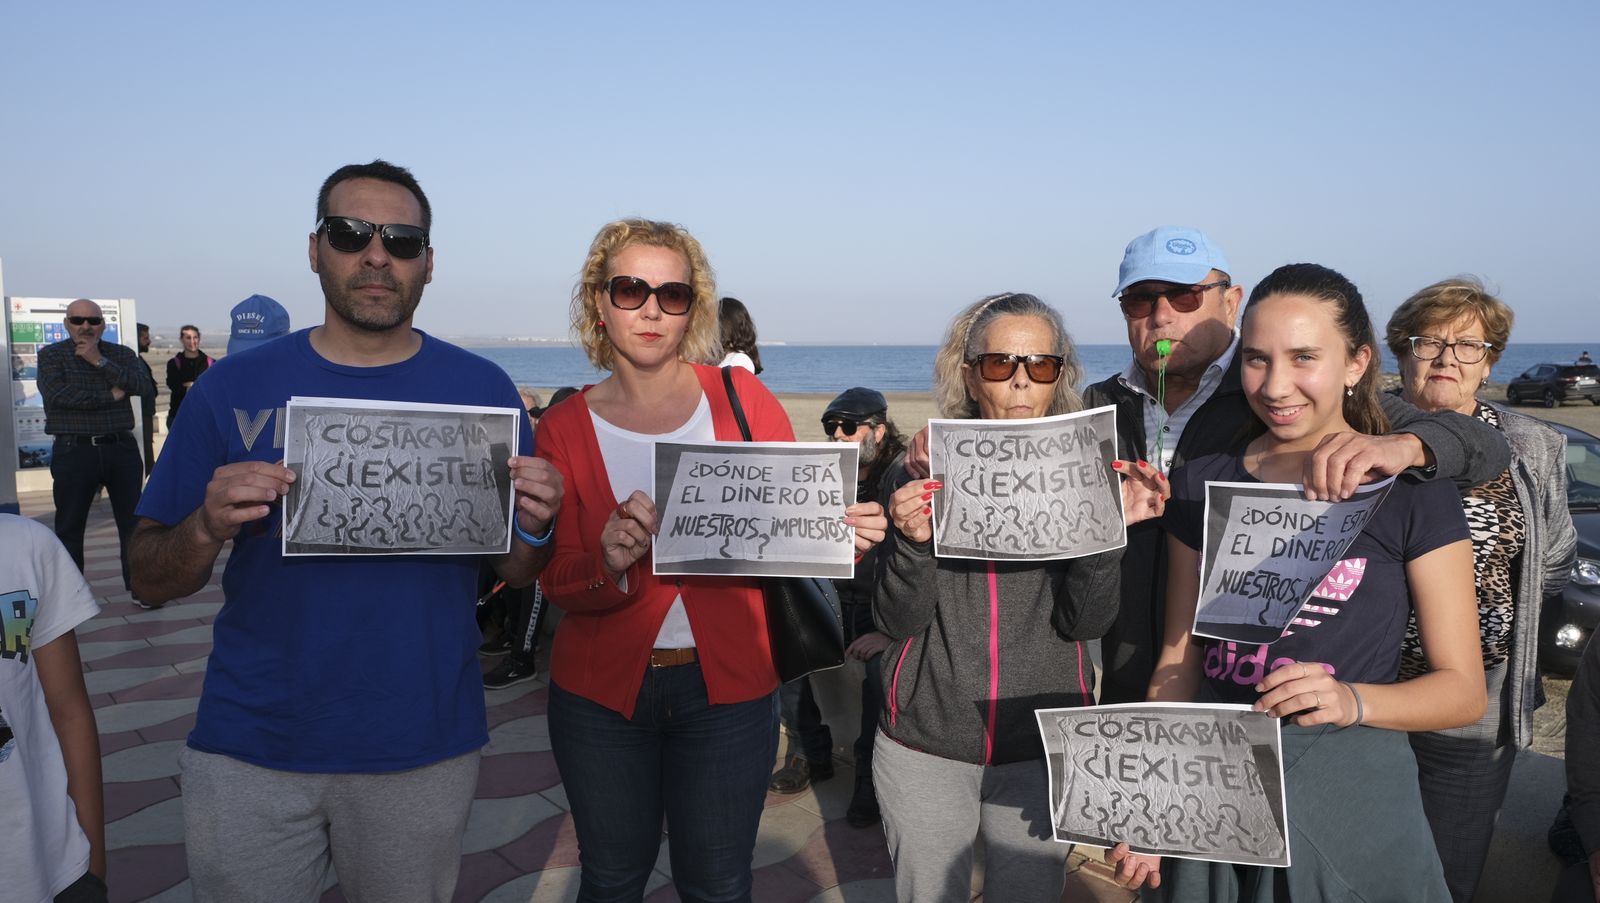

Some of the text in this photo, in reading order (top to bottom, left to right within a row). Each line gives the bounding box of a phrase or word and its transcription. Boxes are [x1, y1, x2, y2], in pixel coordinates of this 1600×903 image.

[236, 312, 265, 323] DIESEL
[321, 421, 490, 450] COSTACABANA
[955, 425, 1099, 462] COSTACABANA
[688, 460, 837, 483] ¿DÓNDE ESTÁ
[680, 485, 705, 504] EL
[818, 489, 842, 506] DE
[669, 513, 760, 541] NUESTROS
[1240, 505, 1329, 535] ¿DÓNDE
[1230, 533, 1255, 555] EL
[1215, 569, 1303, 604] NUESTROS
[1075, 716, 1249, 746] COSTACABANA
